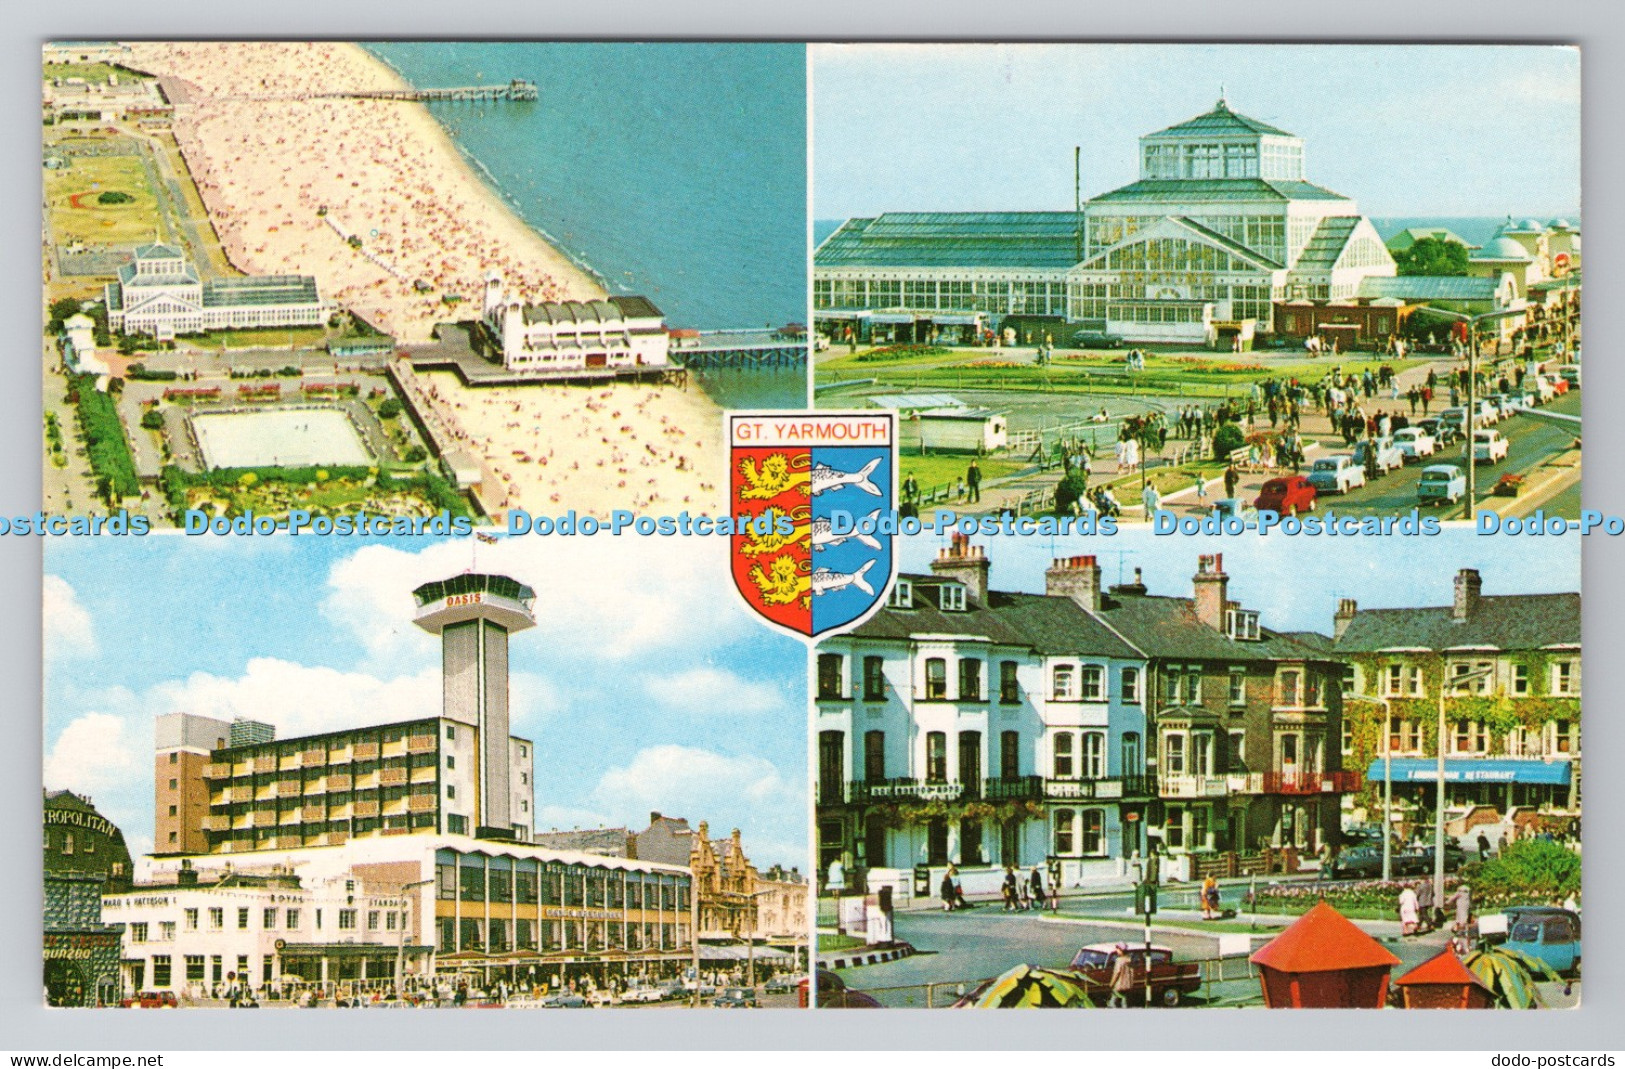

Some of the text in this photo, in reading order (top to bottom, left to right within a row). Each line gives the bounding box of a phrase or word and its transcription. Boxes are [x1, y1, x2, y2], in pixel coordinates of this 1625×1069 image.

[736, 423, 887, 440] GT. YARMOUTH
[446, 593, 482, 607] OASIS
[270, 894, 304, 904] ROYAL
